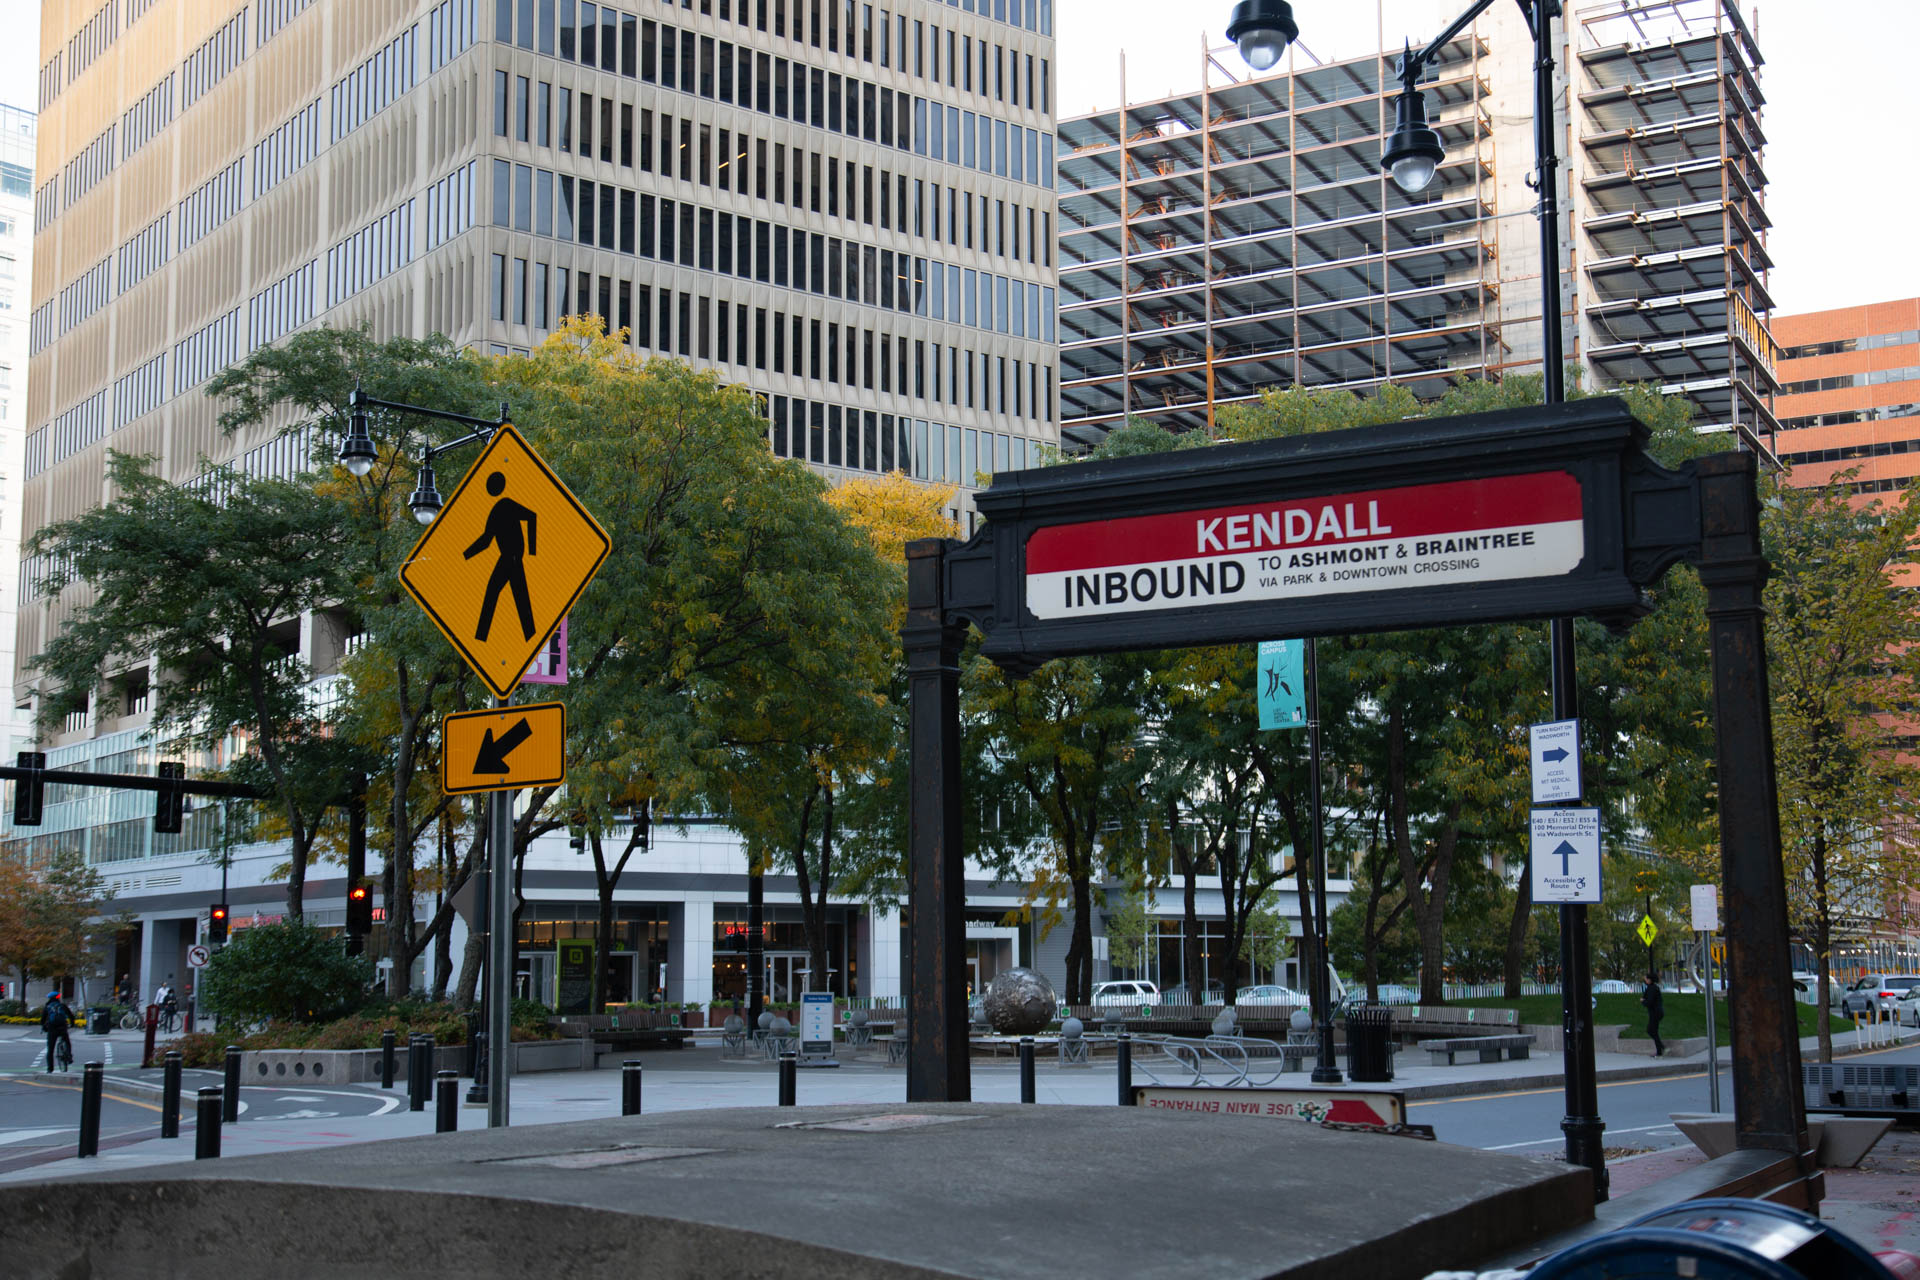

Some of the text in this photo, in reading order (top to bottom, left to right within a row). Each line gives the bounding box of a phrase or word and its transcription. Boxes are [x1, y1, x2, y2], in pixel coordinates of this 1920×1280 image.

[1196, 500, 1392, 553] KENDALL
[1258, 531, 1536, 571] TO ASHMONT & BRAINTREE
[1064, 560, 1246, 609] INBOUND
[1258, 558, 1480, 588] VIA PARK & DOWNTOWN CROSSING
[1261, 646, 1287, 655] CAMPUS
[1539, 732, 1570, 740] WADSWORTH
[965, 919, 996, 930] oadway
[1150, 1099, 1294, 1115] USE MAIN ENTRANCE
